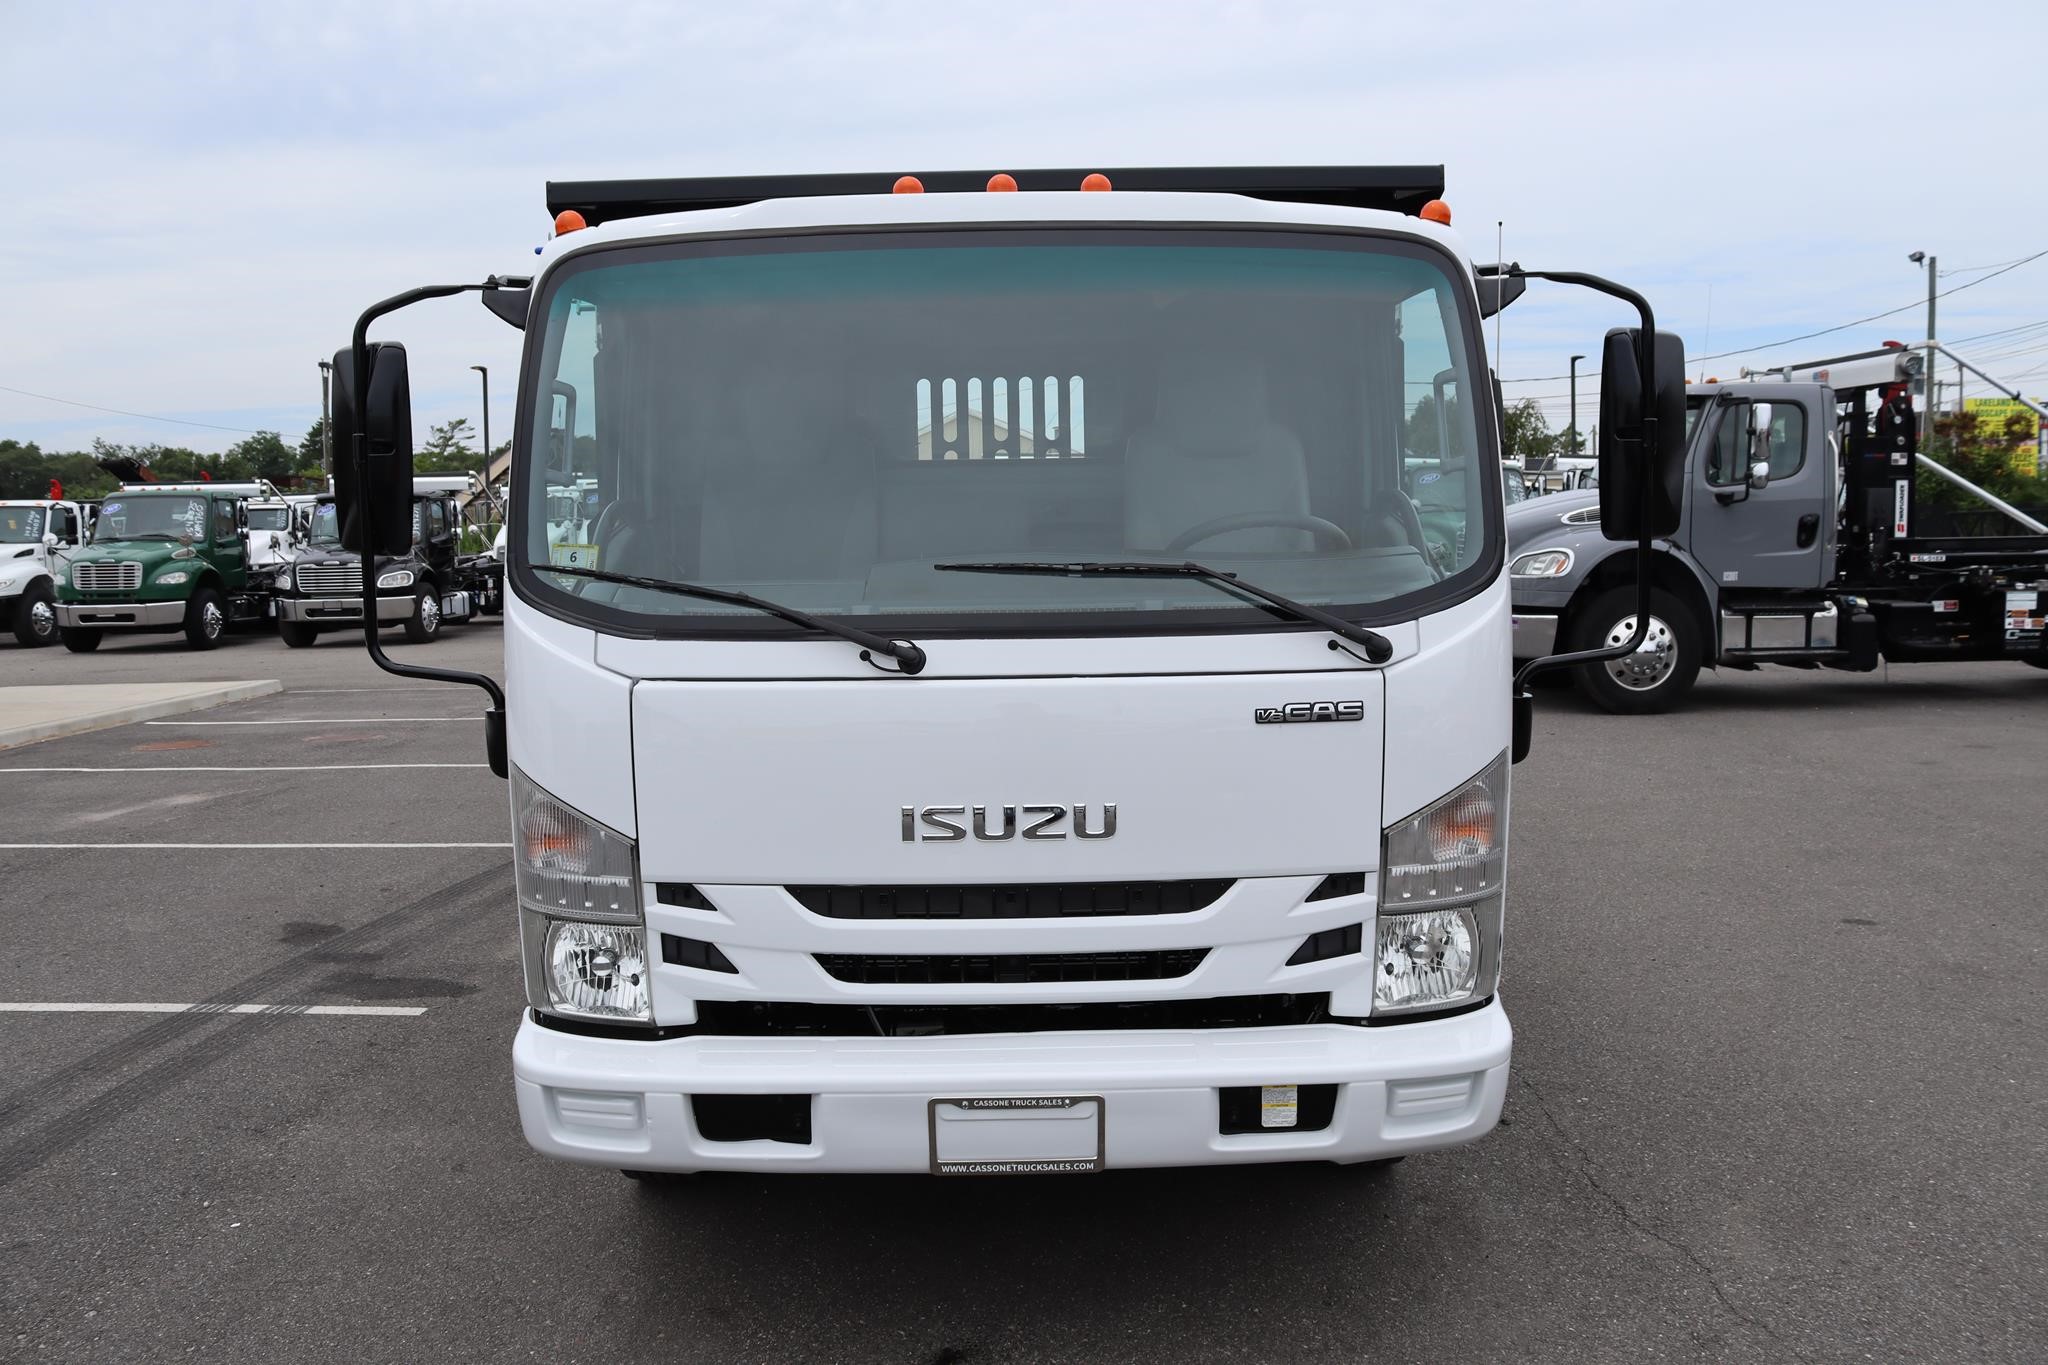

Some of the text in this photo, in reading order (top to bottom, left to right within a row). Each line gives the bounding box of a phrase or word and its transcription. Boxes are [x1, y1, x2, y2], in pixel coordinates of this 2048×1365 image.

[569, 551, 578, 563] 6
[901, 803, 1117, 842] ISUZU
[973, 1098, 1063, 1107] CASSONE TRUCK SALES
[941, 1162, 1094, 1173] WWW.CASSONETRUCKSALES.COM
